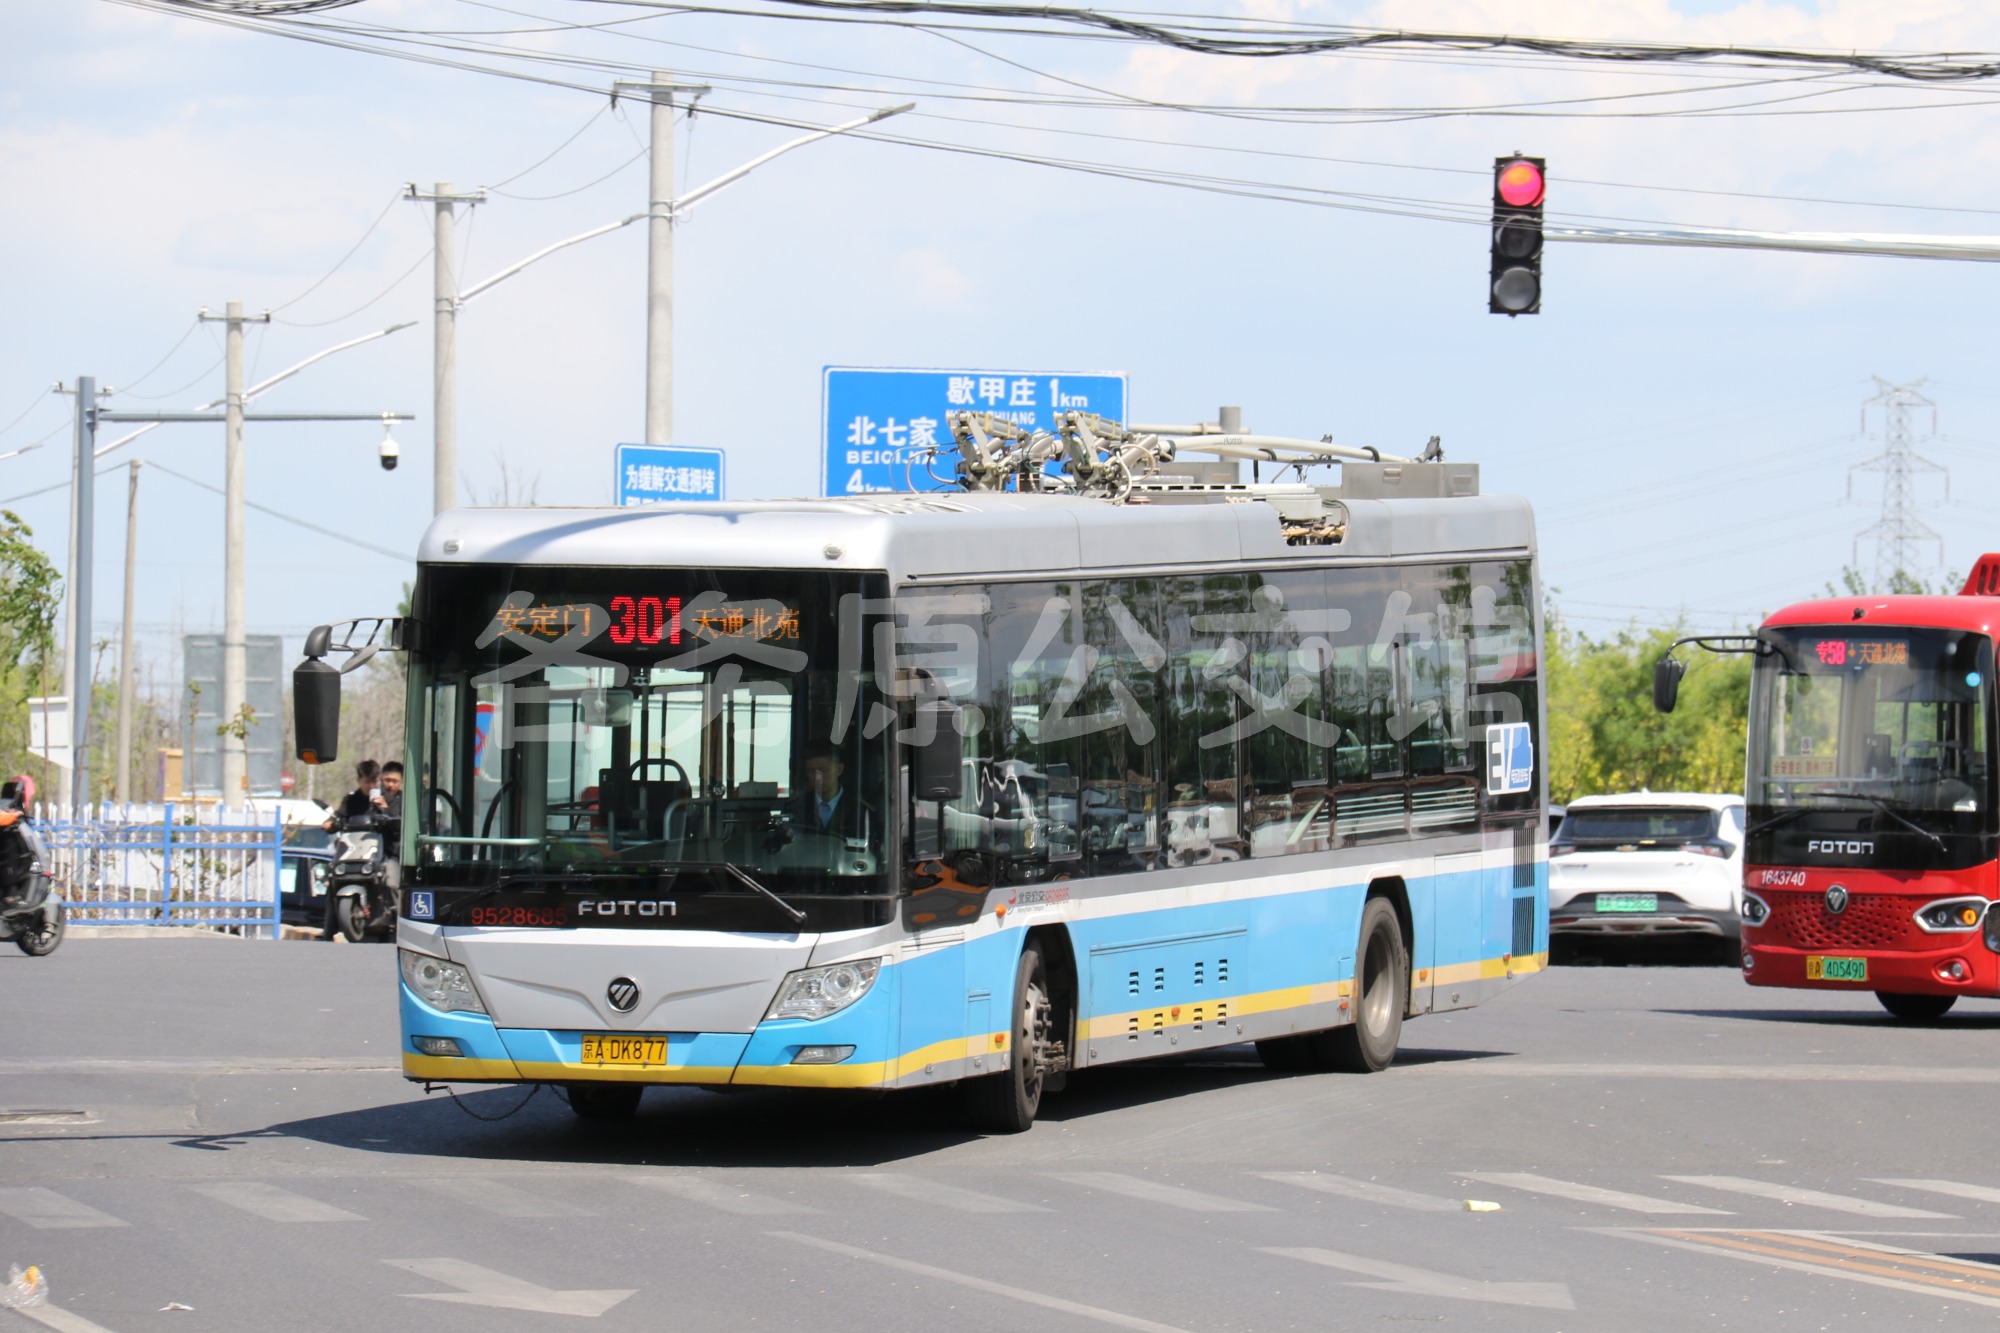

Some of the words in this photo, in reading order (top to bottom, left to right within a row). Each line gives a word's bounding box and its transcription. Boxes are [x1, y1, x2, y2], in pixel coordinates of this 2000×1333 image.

[946, 376, 1037, 406] 歇甲庄
[1049, 378, 1088, 408] 1km
[847, 416, 938, 447] 北七家
[625, 464, 715, 495] 为缓解交通拥堵
[496, 603, 591, 637] 安定门
[609, 596, 681, 645] 301
[691, 607, 800, 640] 天通北苑
[1808, 840, 1874, 854] FOTON
[1761, 870, 1807, 886] 1643740
[471, 907, 569, 925] 9528685
[578, 901, 677, 916] FOTON
